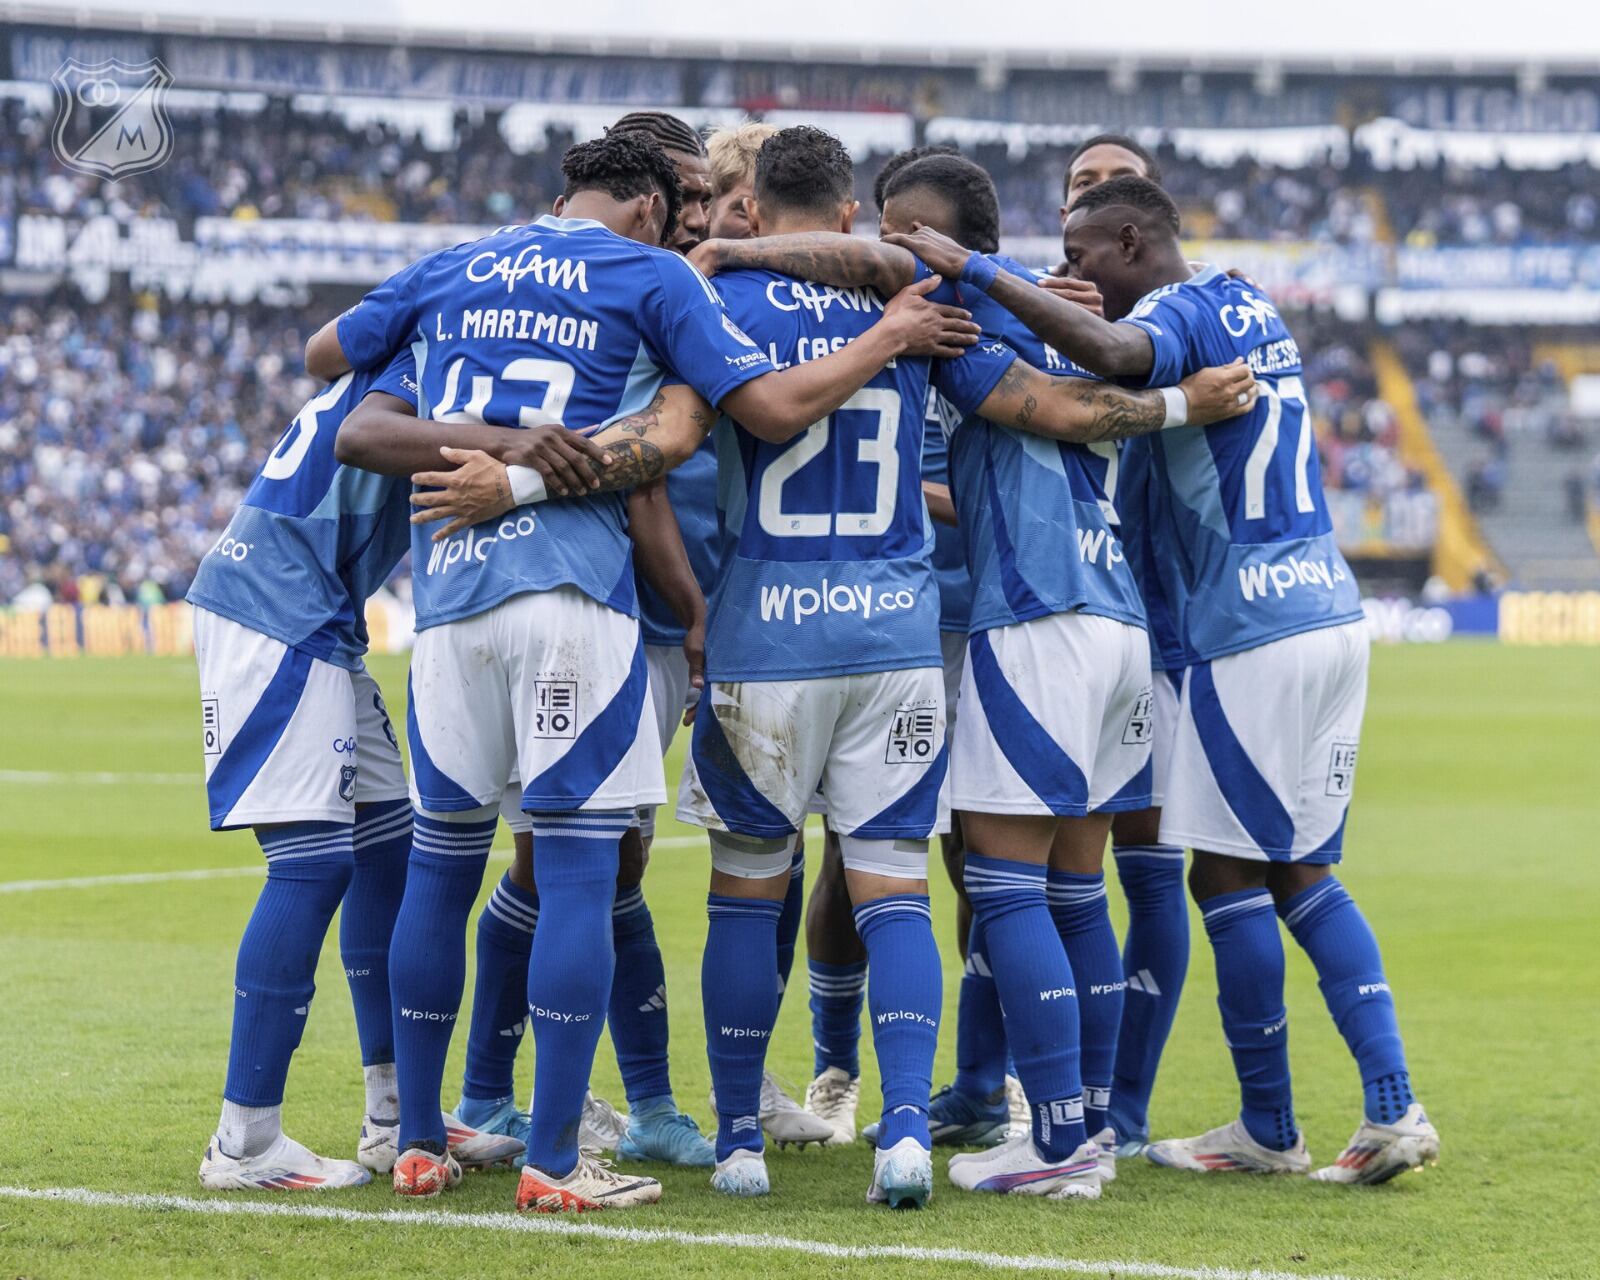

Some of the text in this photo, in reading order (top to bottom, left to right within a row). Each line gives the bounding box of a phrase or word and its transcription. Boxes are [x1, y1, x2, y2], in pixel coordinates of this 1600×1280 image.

[436, 309, 599, 351] L. MARIMON
[769, 342, 791, 370] L.
[758, 387, 902, 538] 23
[1244, 376, 1317, 520] 77
[760, 578, 915, 625] Wplay.co
